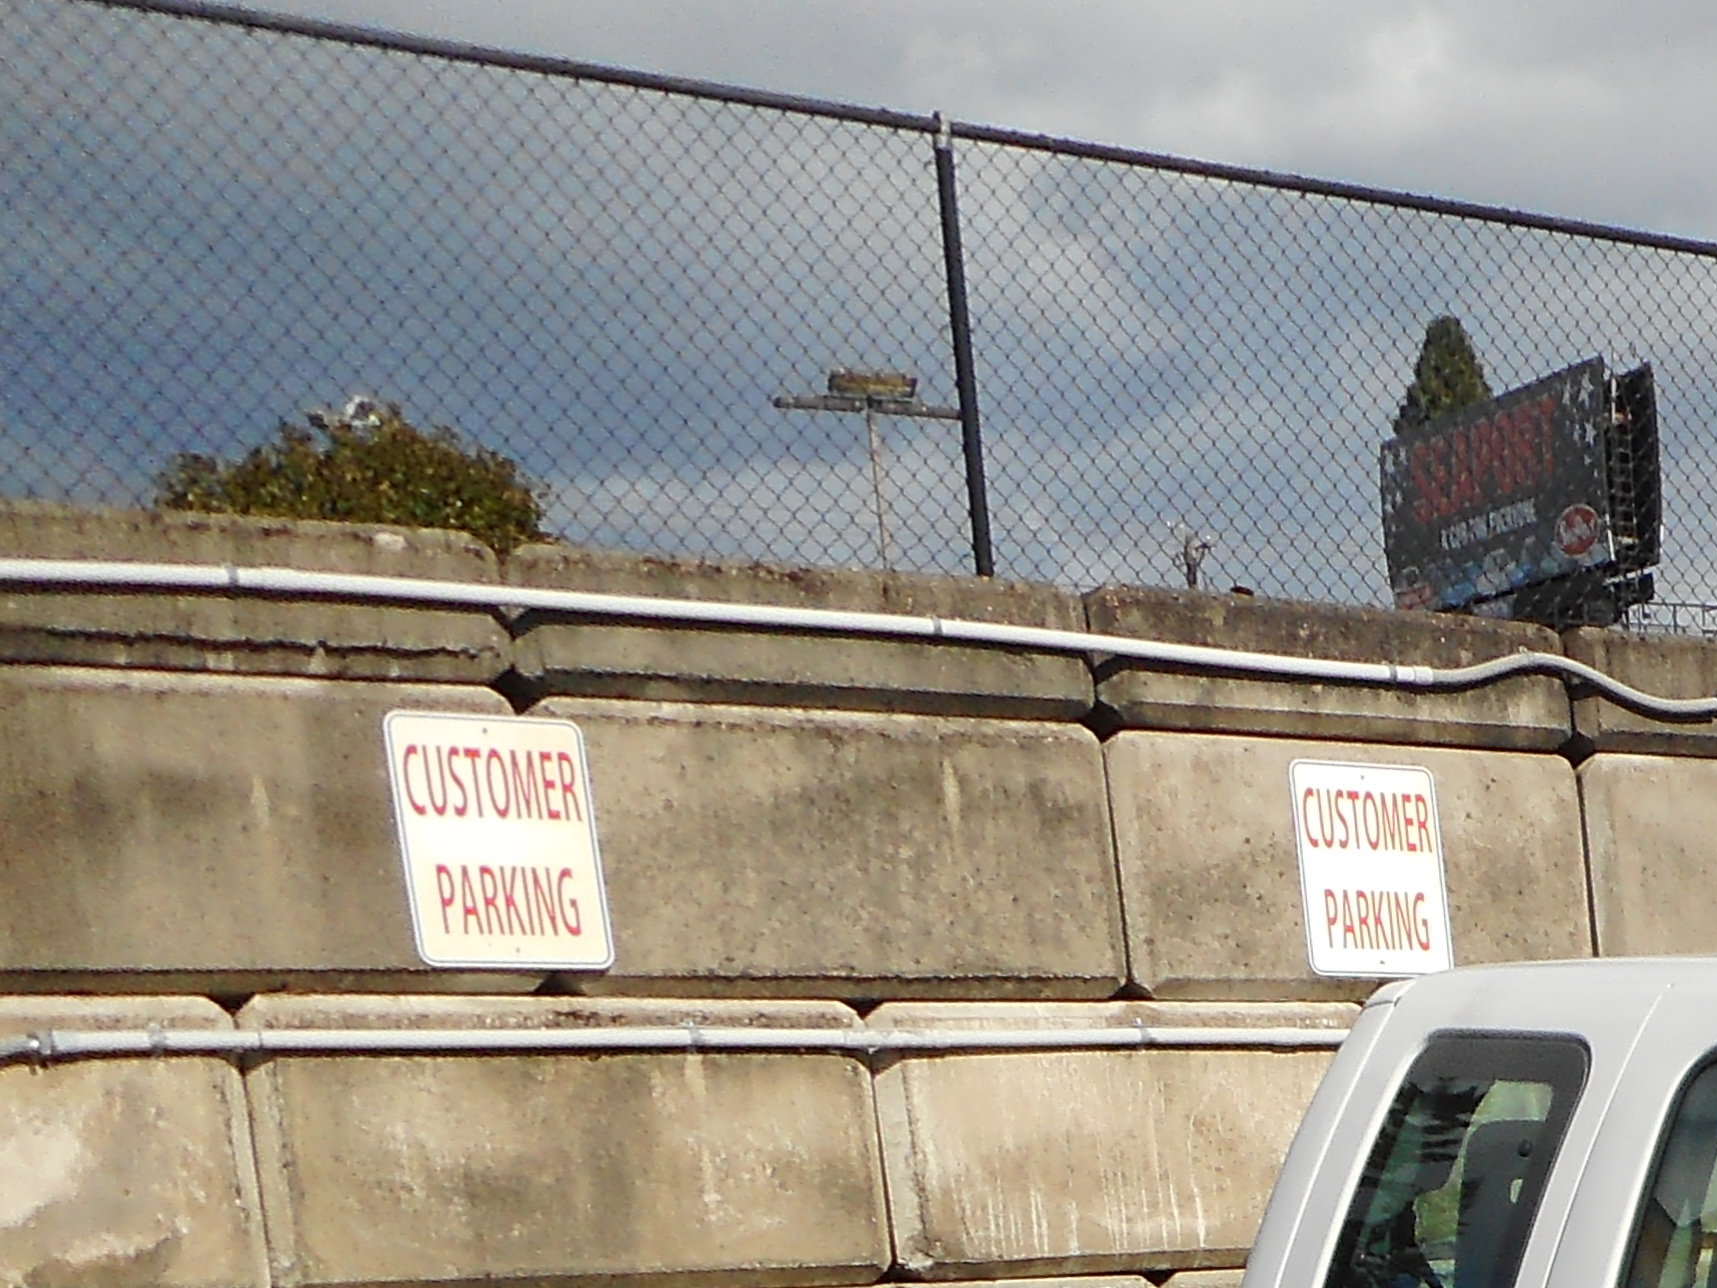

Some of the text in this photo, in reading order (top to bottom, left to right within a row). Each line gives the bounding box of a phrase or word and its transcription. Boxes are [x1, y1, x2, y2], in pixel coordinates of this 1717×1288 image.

[402, 743, 583, 822] CUSTOMER
[1302, 787, 1433, 853] CUSTOMER
[435, 863, 582, 937] PARKING
[1323, 888, 1431, 952] PARKING
